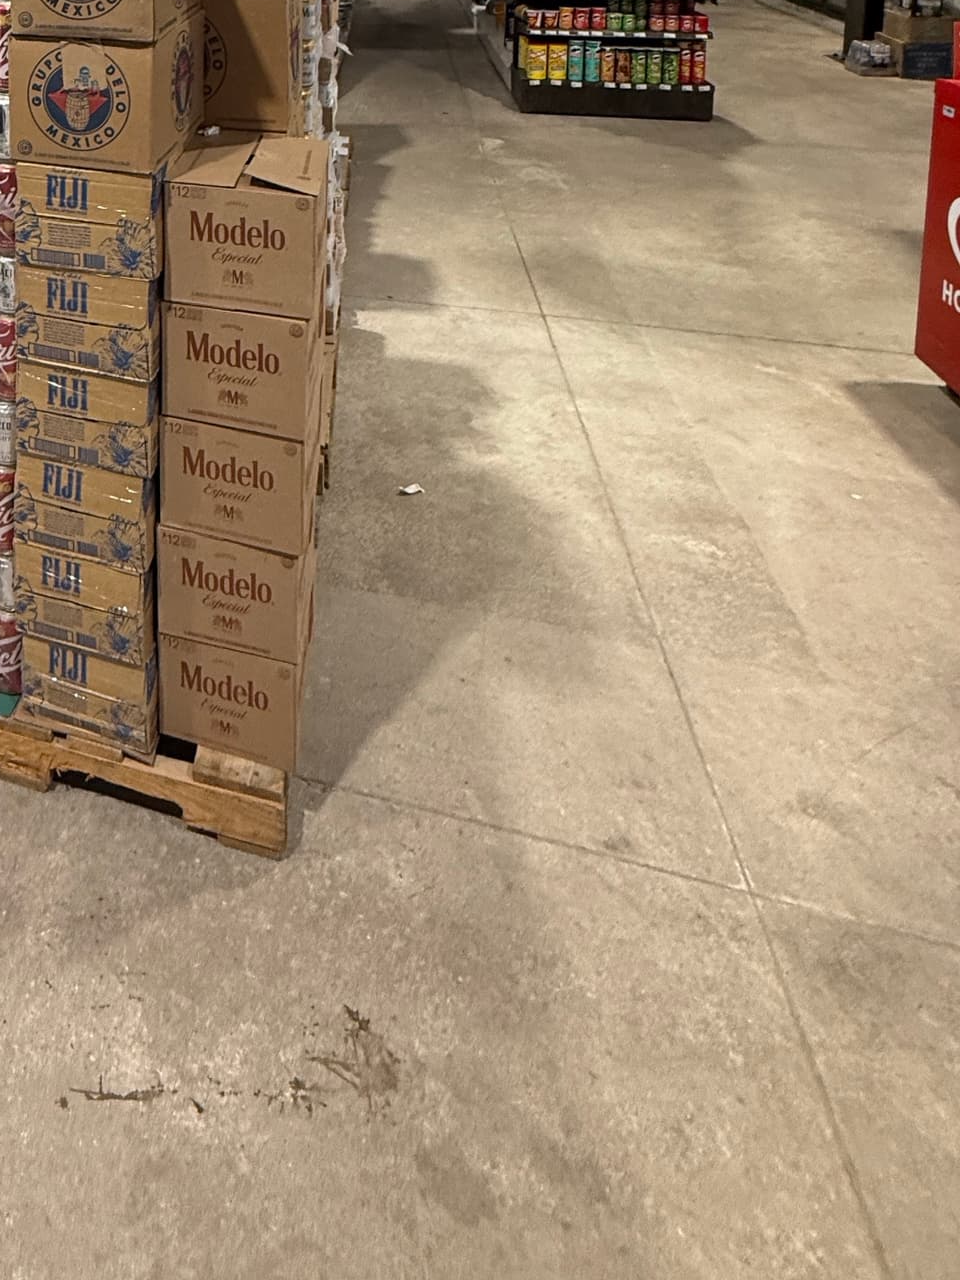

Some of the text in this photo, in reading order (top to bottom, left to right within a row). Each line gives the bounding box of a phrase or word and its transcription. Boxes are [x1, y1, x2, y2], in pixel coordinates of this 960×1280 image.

[45, 124, 116, 149] MEXICO
[45, 173, 89, 211] FIJI
[189, 209, 286, 251] Modelo
[211, 246, 264, 265] Especial
[46, 277, 89, 314] FIJI
[231, 269, 244, 285] M
[185, 329, 280, 375] Modelo
[47, 374, 89, 411] FIJI
[207, 367, 258, 387] Especial
[226, 389, 239, 405] M
[42, 462, 84, 502] FIJI
[182, 445, 275, 492] Modelo
[202, 483, 253, 502] Especial
[223, 504, 234, 519] M
[41, 554, 82, 594] FIJI
[181, 557, 273, 604] Modelo
[202, 594, 252, 614] Especial
[48, 642, 88, 685] FIJI
[180, 660, 269, 712] Modelo
